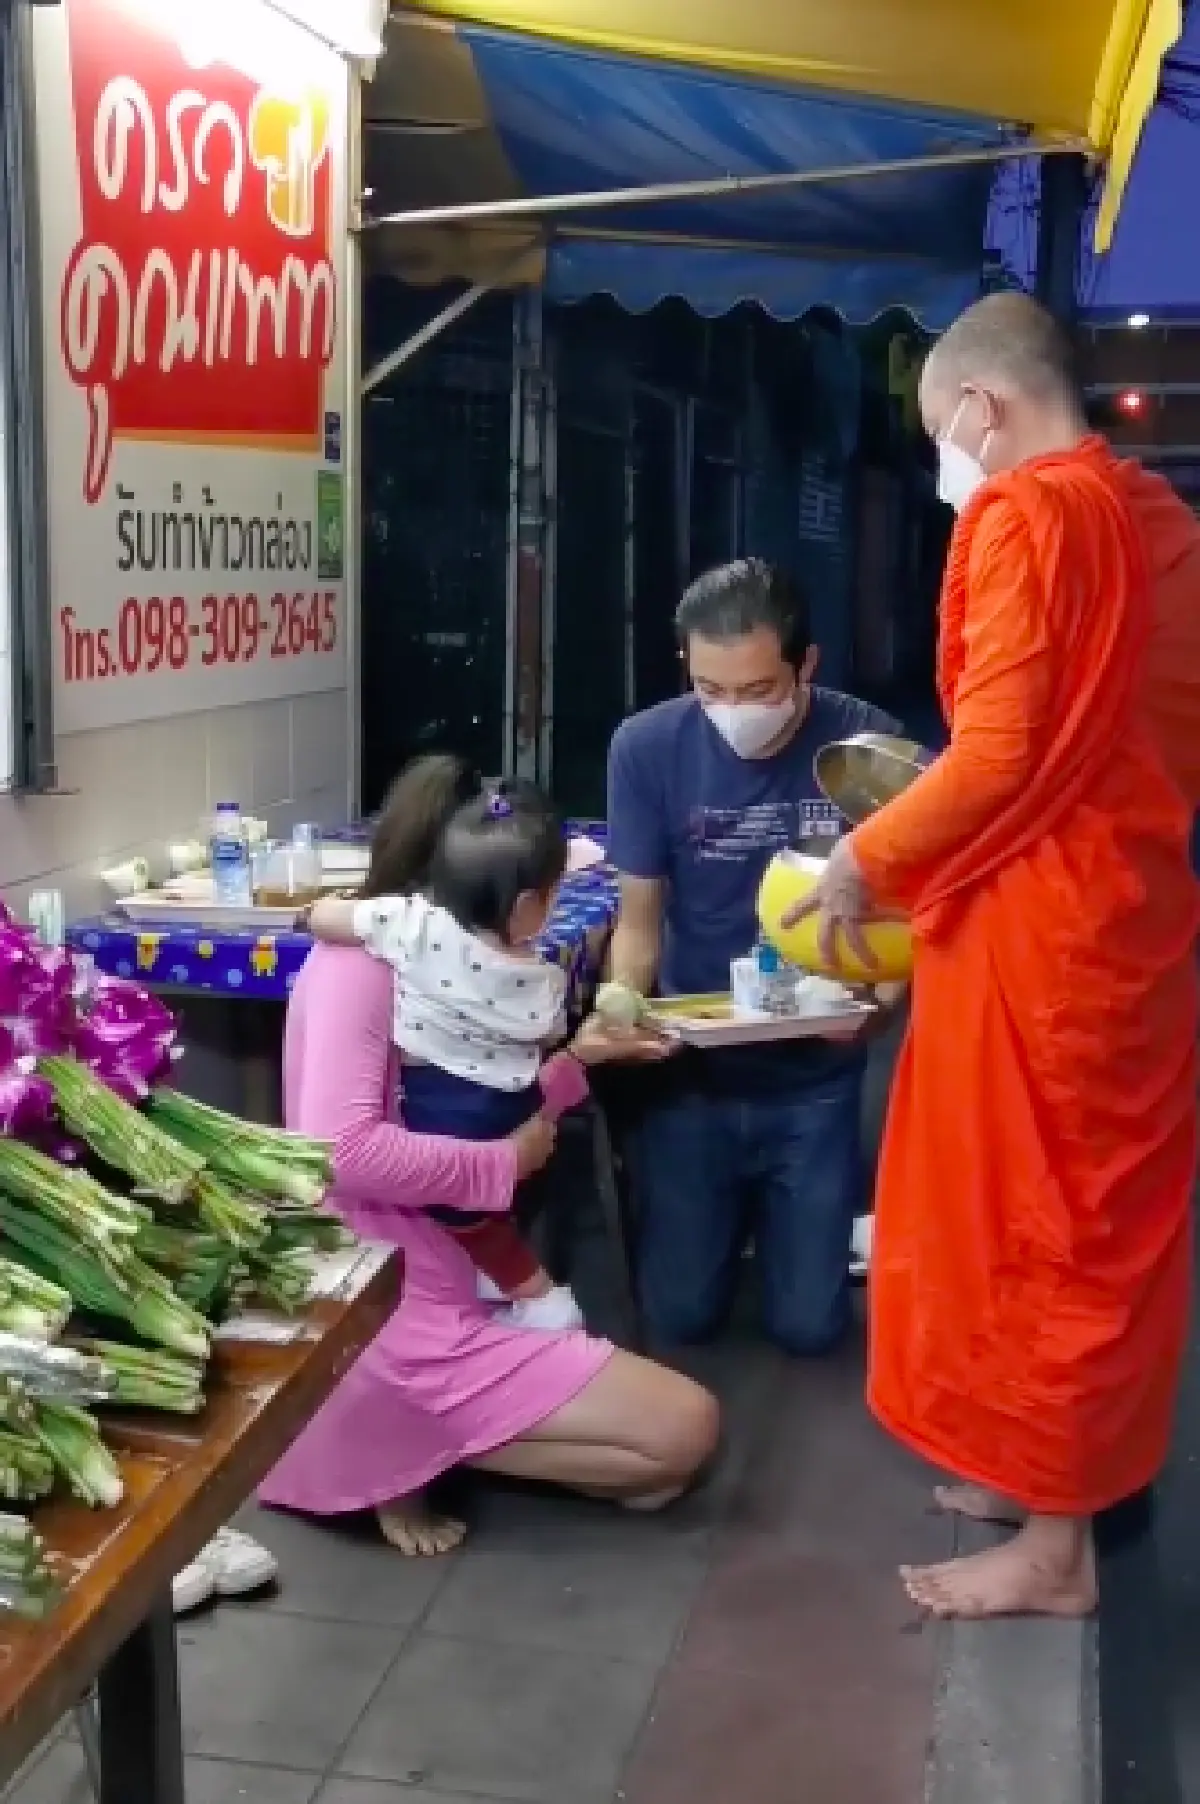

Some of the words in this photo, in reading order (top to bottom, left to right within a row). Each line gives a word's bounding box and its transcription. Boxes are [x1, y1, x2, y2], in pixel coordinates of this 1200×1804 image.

[94, 75, 243, 217] ครว
[116, 481, 312, 571] รับทำข้าวกล่อง
